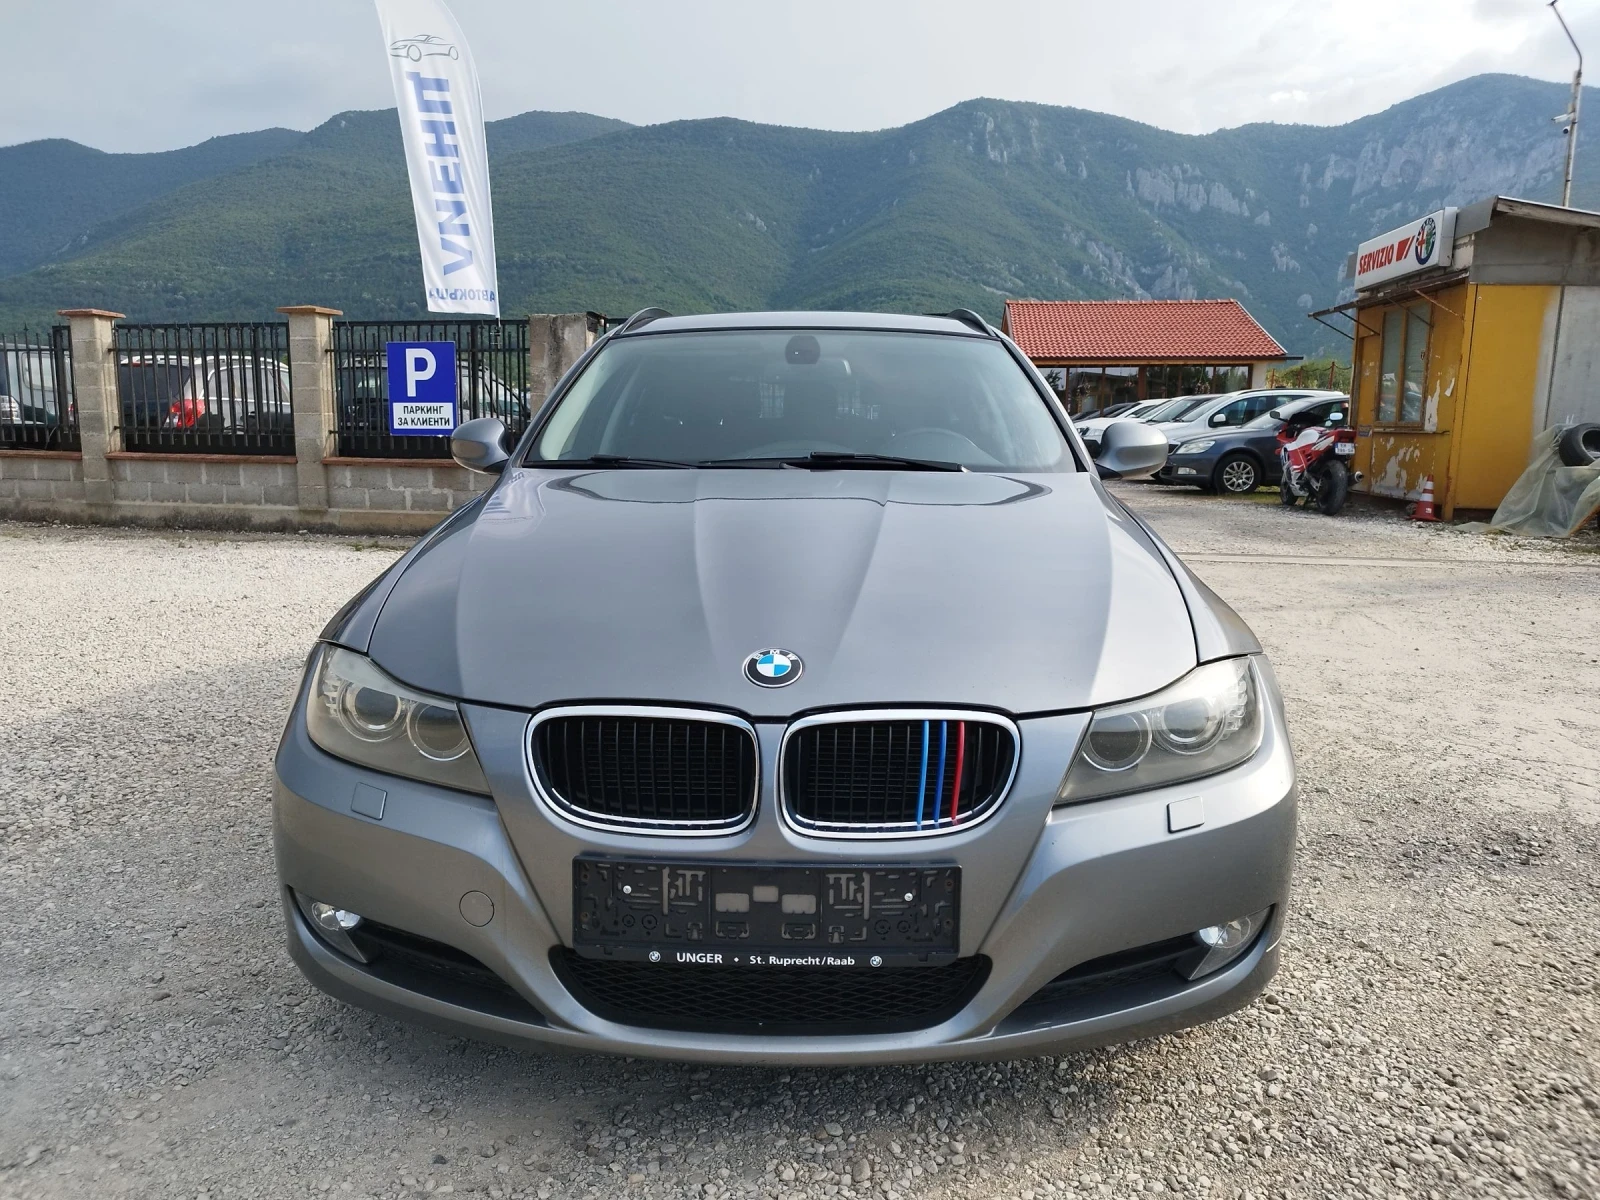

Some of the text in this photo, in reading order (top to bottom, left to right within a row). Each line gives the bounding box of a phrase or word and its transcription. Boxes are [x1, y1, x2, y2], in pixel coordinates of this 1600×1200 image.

[1358, 244, 1395, 276] SERVIZIO
[405, 348, 437, 397] P
[403, 405, 444, 415] ПАРКИНГ
[397, 417, 450, 426] ЗА КЛИЕНТИ
[676, 952, 855, 966] UNGER St. Ruprecht/Raab
